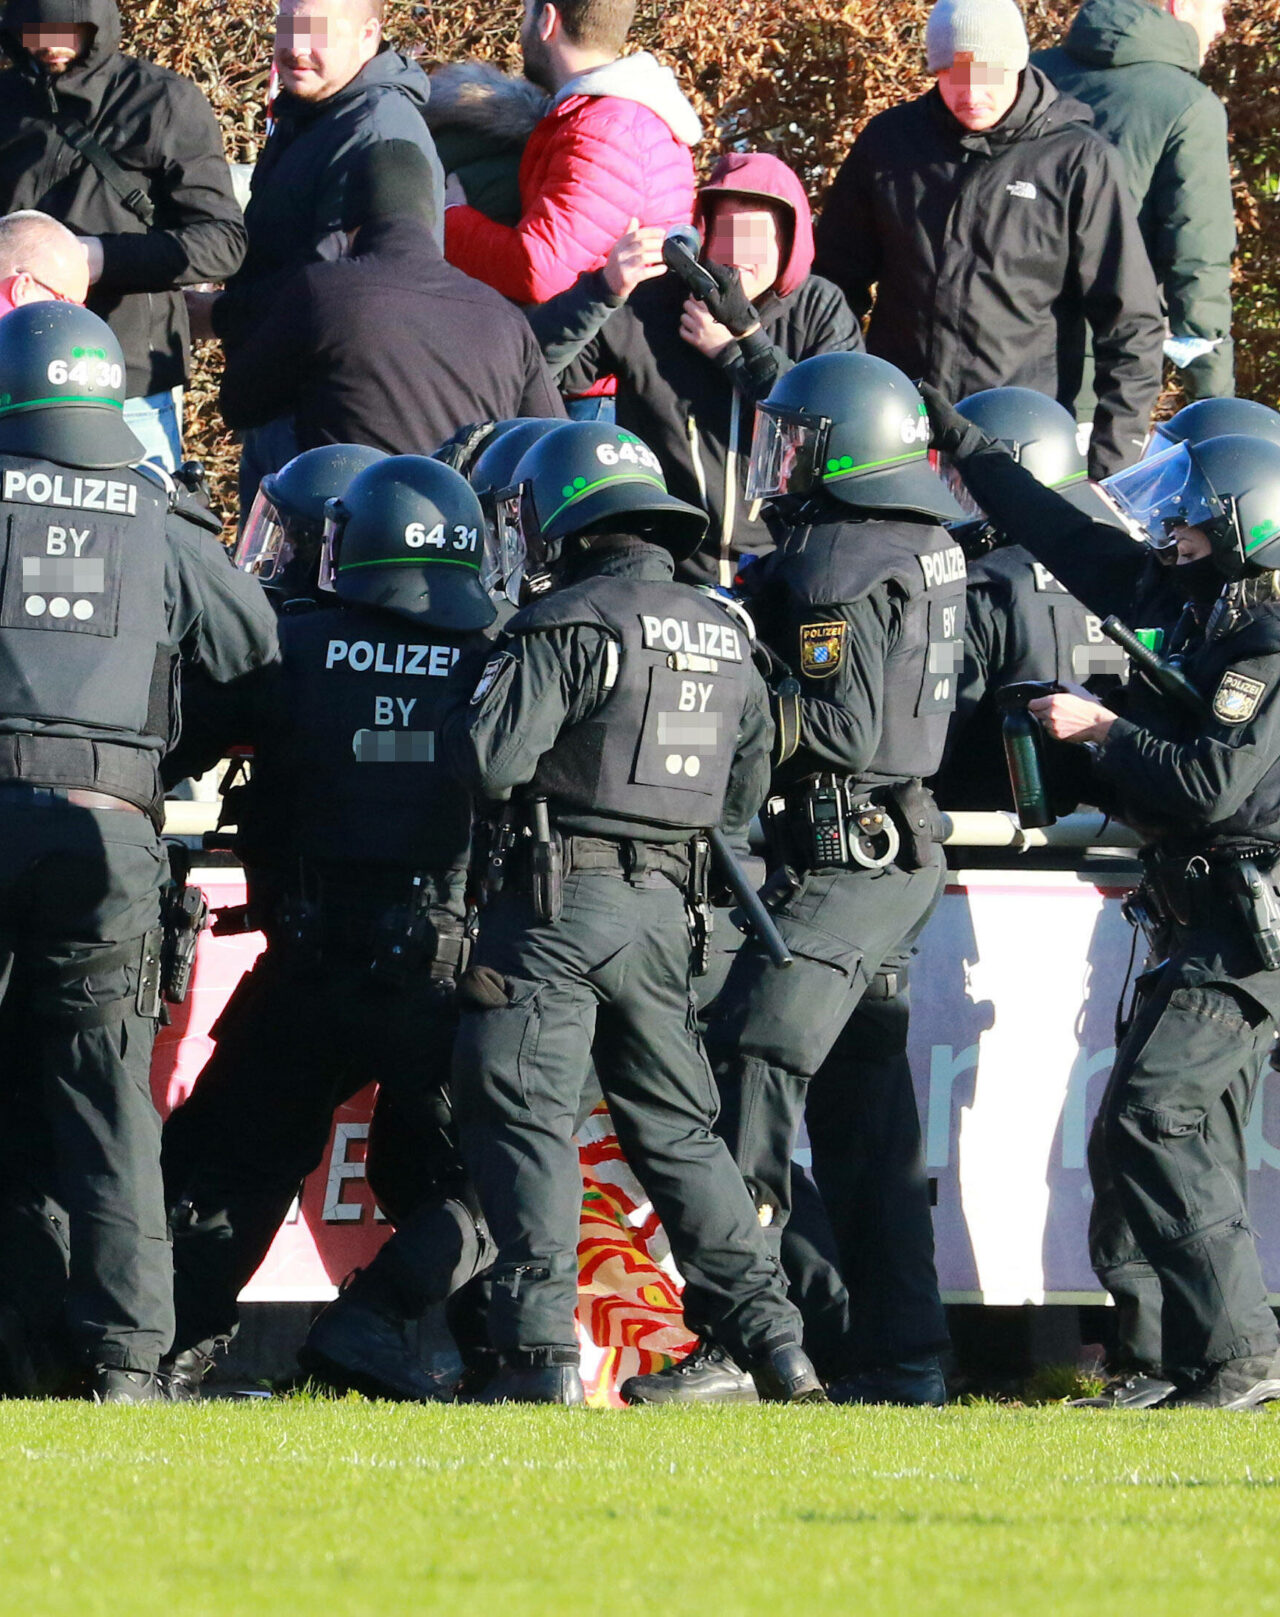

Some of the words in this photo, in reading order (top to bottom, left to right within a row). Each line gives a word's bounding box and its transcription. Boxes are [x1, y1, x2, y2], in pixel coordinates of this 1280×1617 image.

[4, 470, 137, 515] POLIZEI
[46, 526, 90, 557] BY
[803, 626, 842, 639] POLIZEI
[943, 606, 957, 638] BY
[643, 615, 743, 661] POLIZEI
[678, 680, 714, 712] BY
[1224, 676, 1259, 696] POLIZEI
[375, 696, 417, 727] BY
